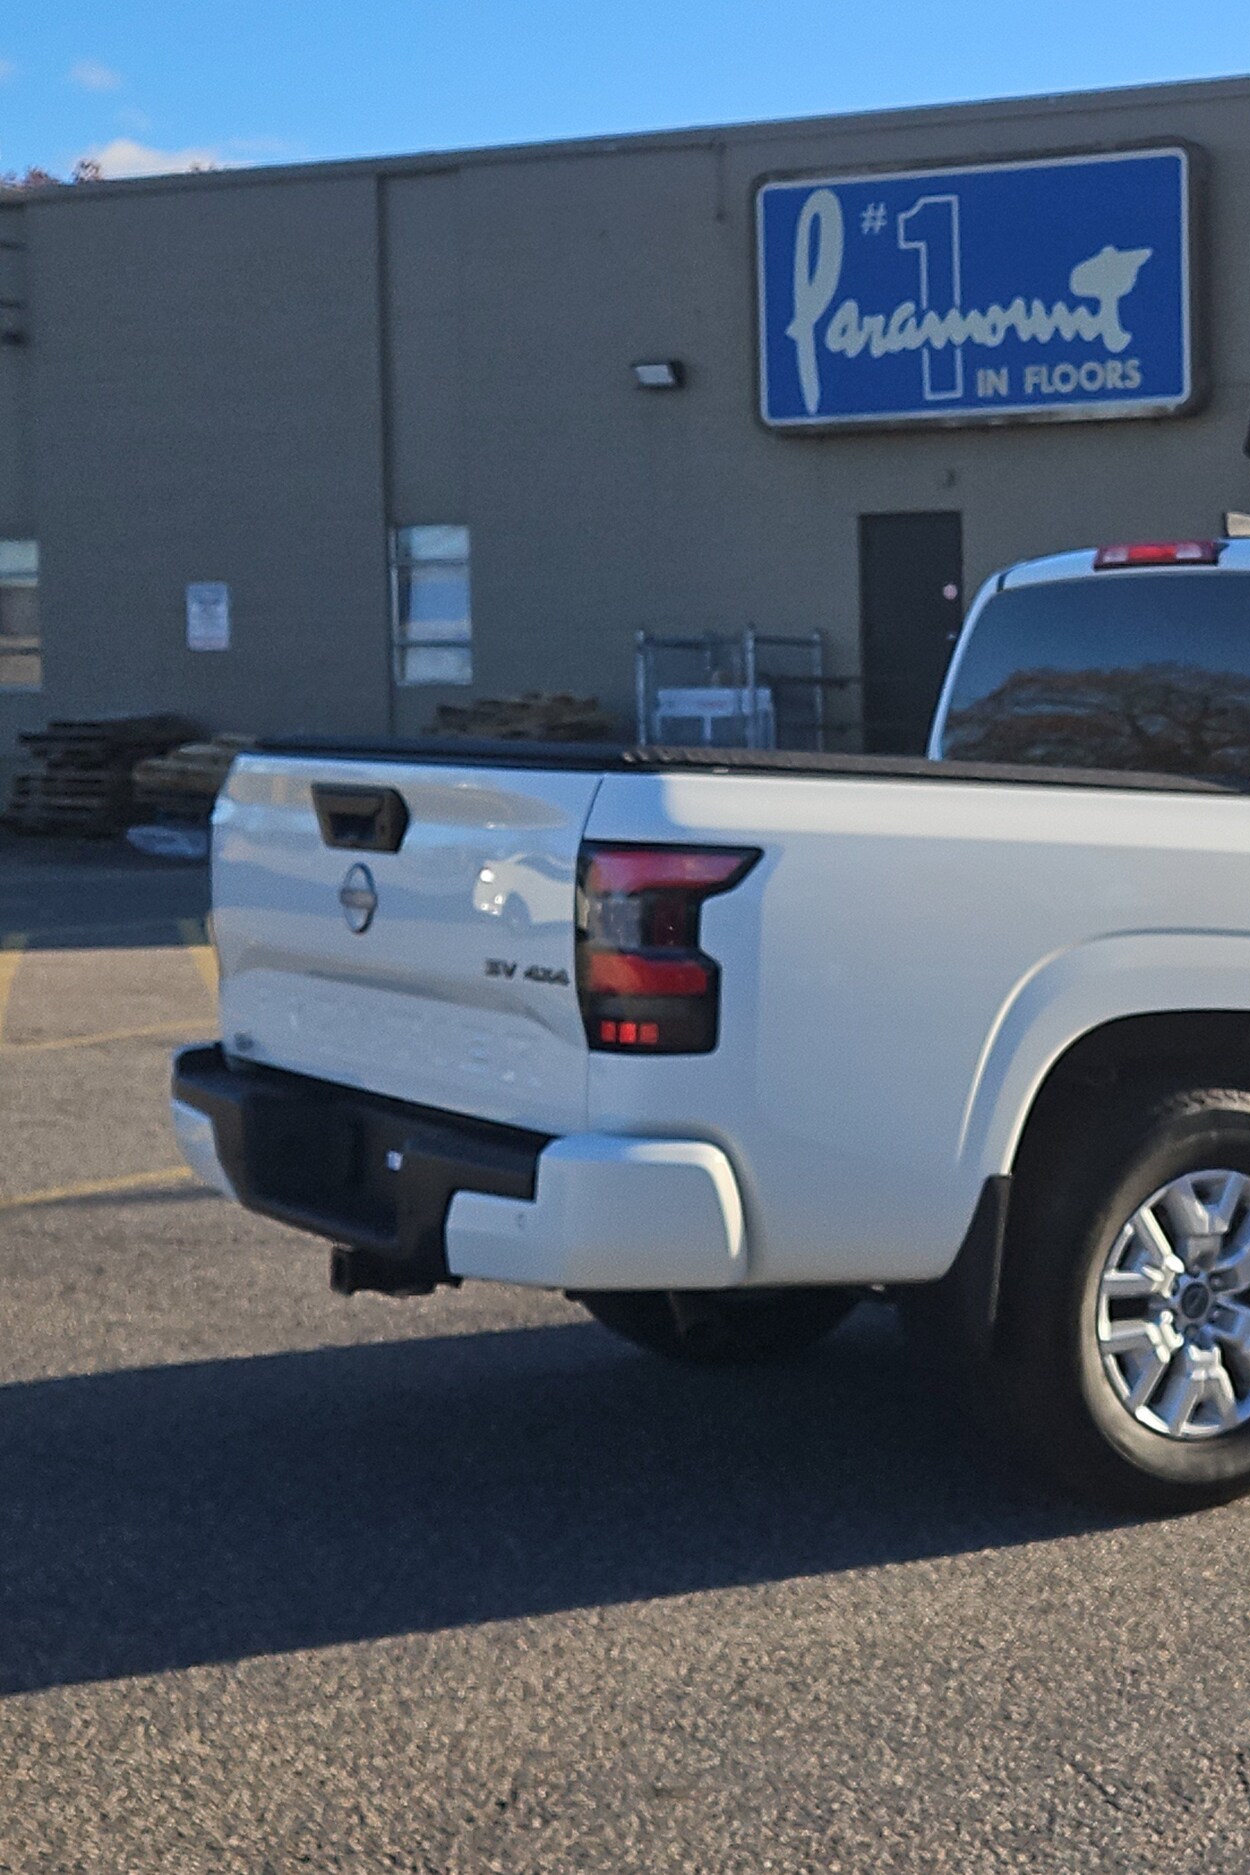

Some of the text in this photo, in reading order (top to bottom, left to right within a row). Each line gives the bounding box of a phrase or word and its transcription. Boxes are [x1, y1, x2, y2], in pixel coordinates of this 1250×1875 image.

[787, 189, 1153, 416] Paramount
[977, 360, 1142, 398] IN FLOORS
